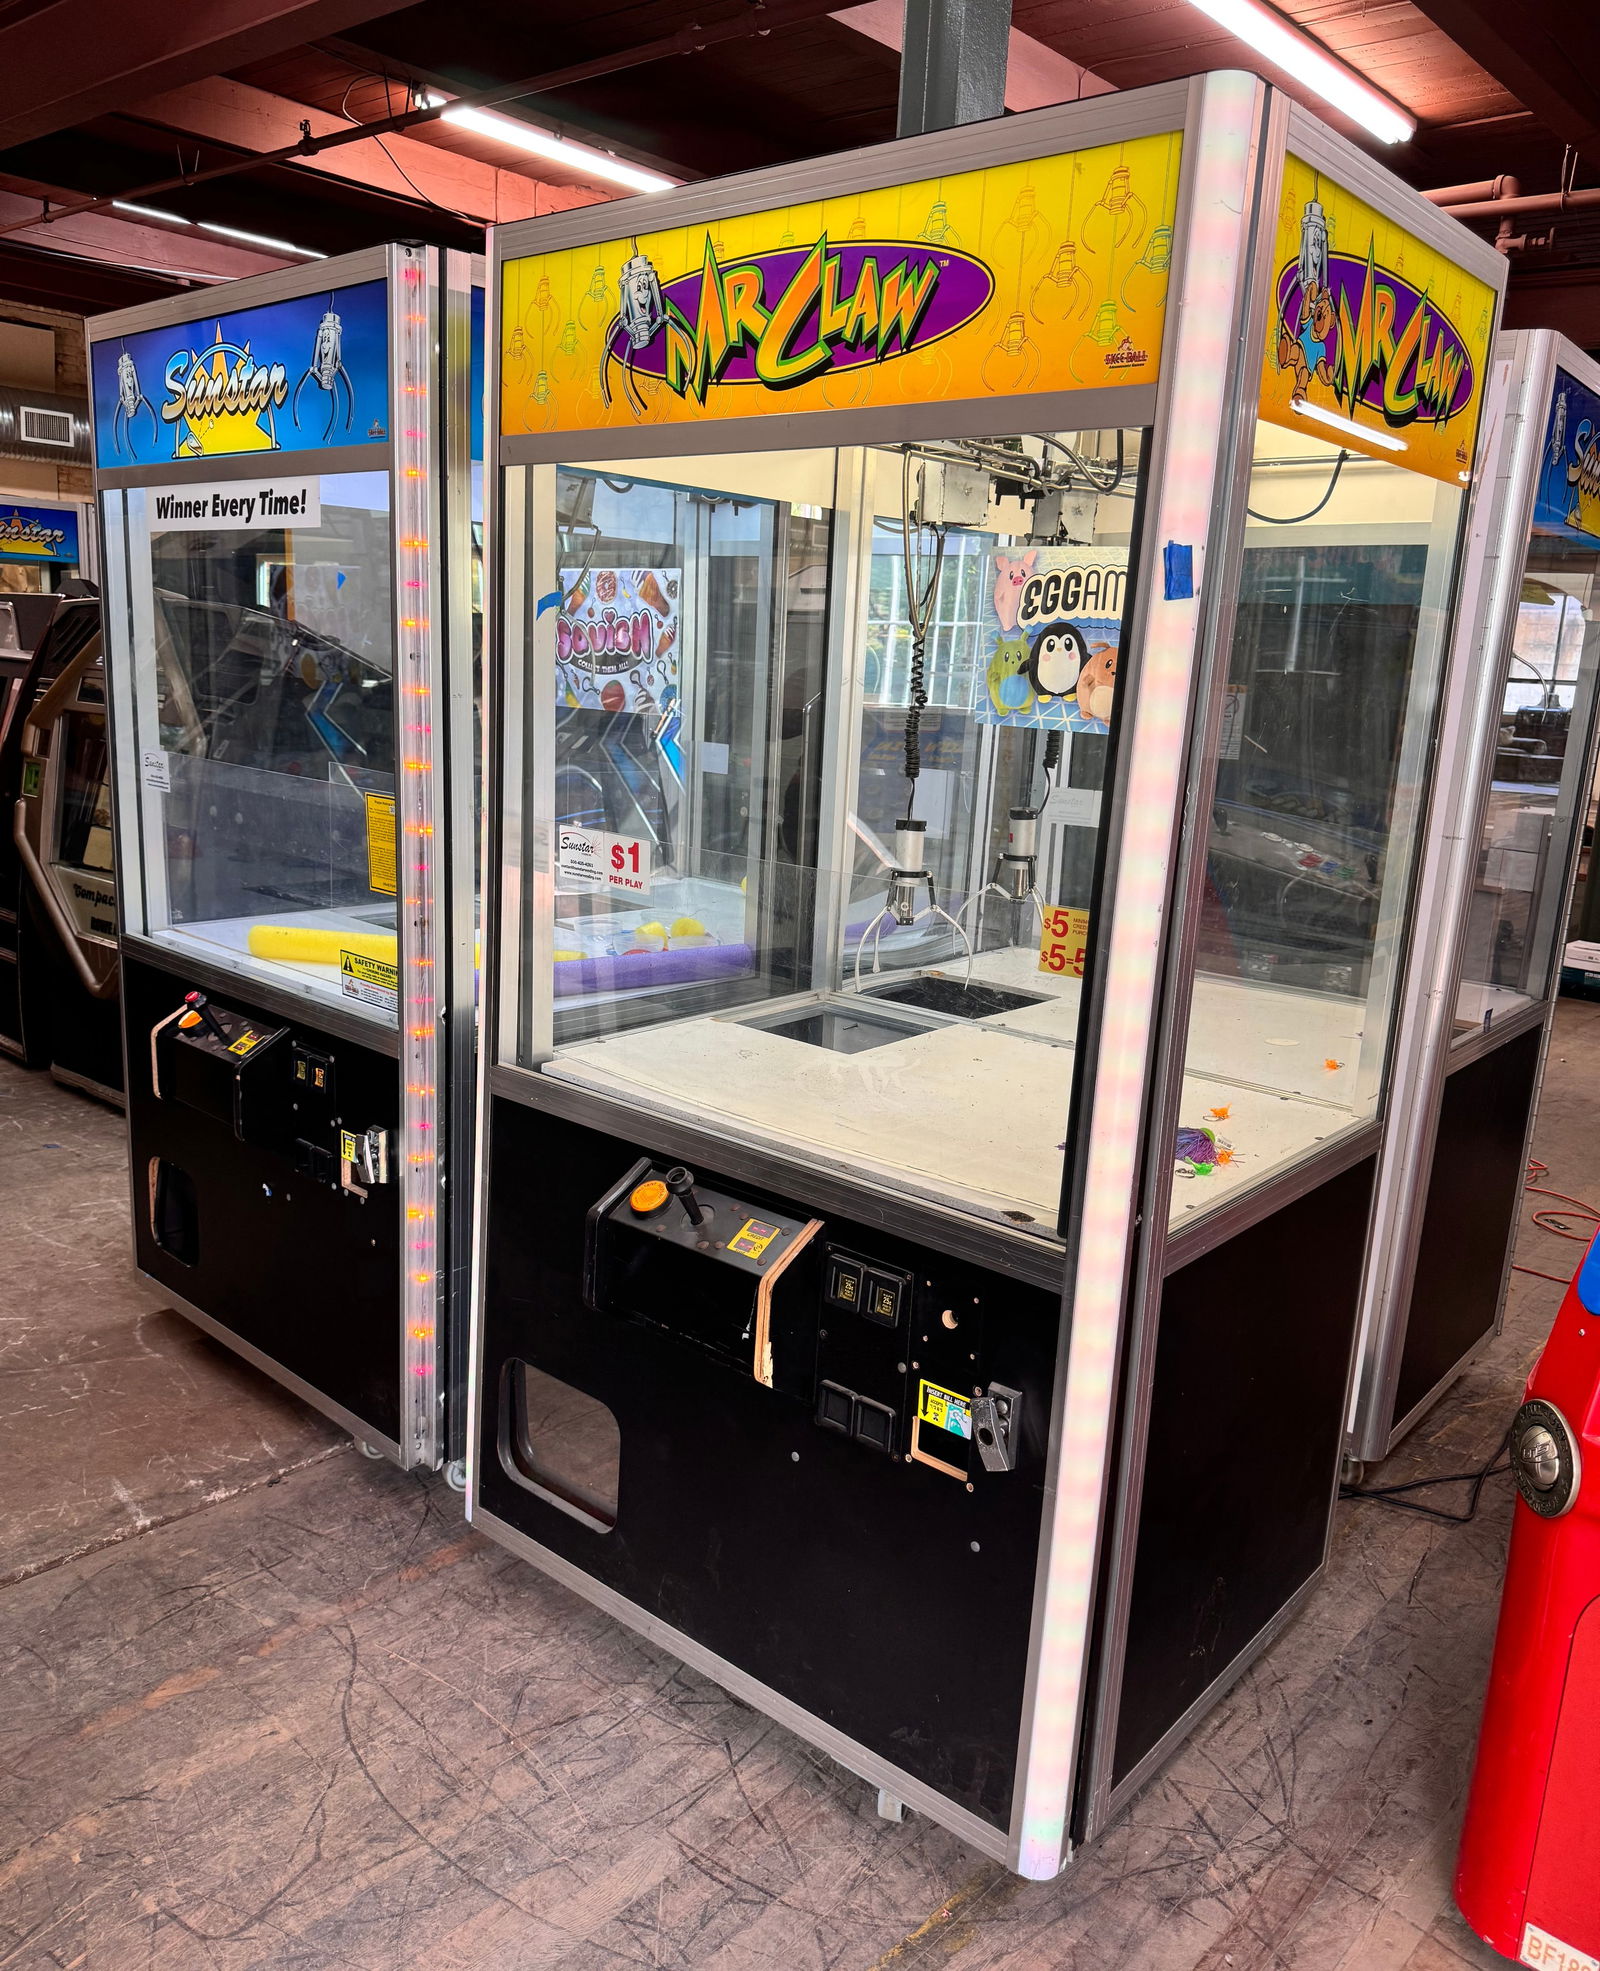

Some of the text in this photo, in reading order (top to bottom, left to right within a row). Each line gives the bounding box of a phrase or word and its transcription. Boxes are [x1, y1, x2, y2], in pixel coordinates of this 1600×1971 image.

[755, 229, 941, 392] CLAW
[1384, 287, 1466, 431] CLAW
[161, 350, 289, 424] Sunstar
[156, 488, 307, 524] Winner Every Time!
[556, 608, 654, 664] SQUISH
[560, 836, 595, 854] Sunstar
[610, 841, 640, 874] $1
[608, 874, 644, 890] PER PLAY
[1043, 909, 1070, 938] $5
[354, 957, 375, 968] SAFETY
[926, 1385, 943, 1398] INSERT
[943, 1393, 953, 1403] BILL
[1527, 1934, 1592, 1971] BF18
